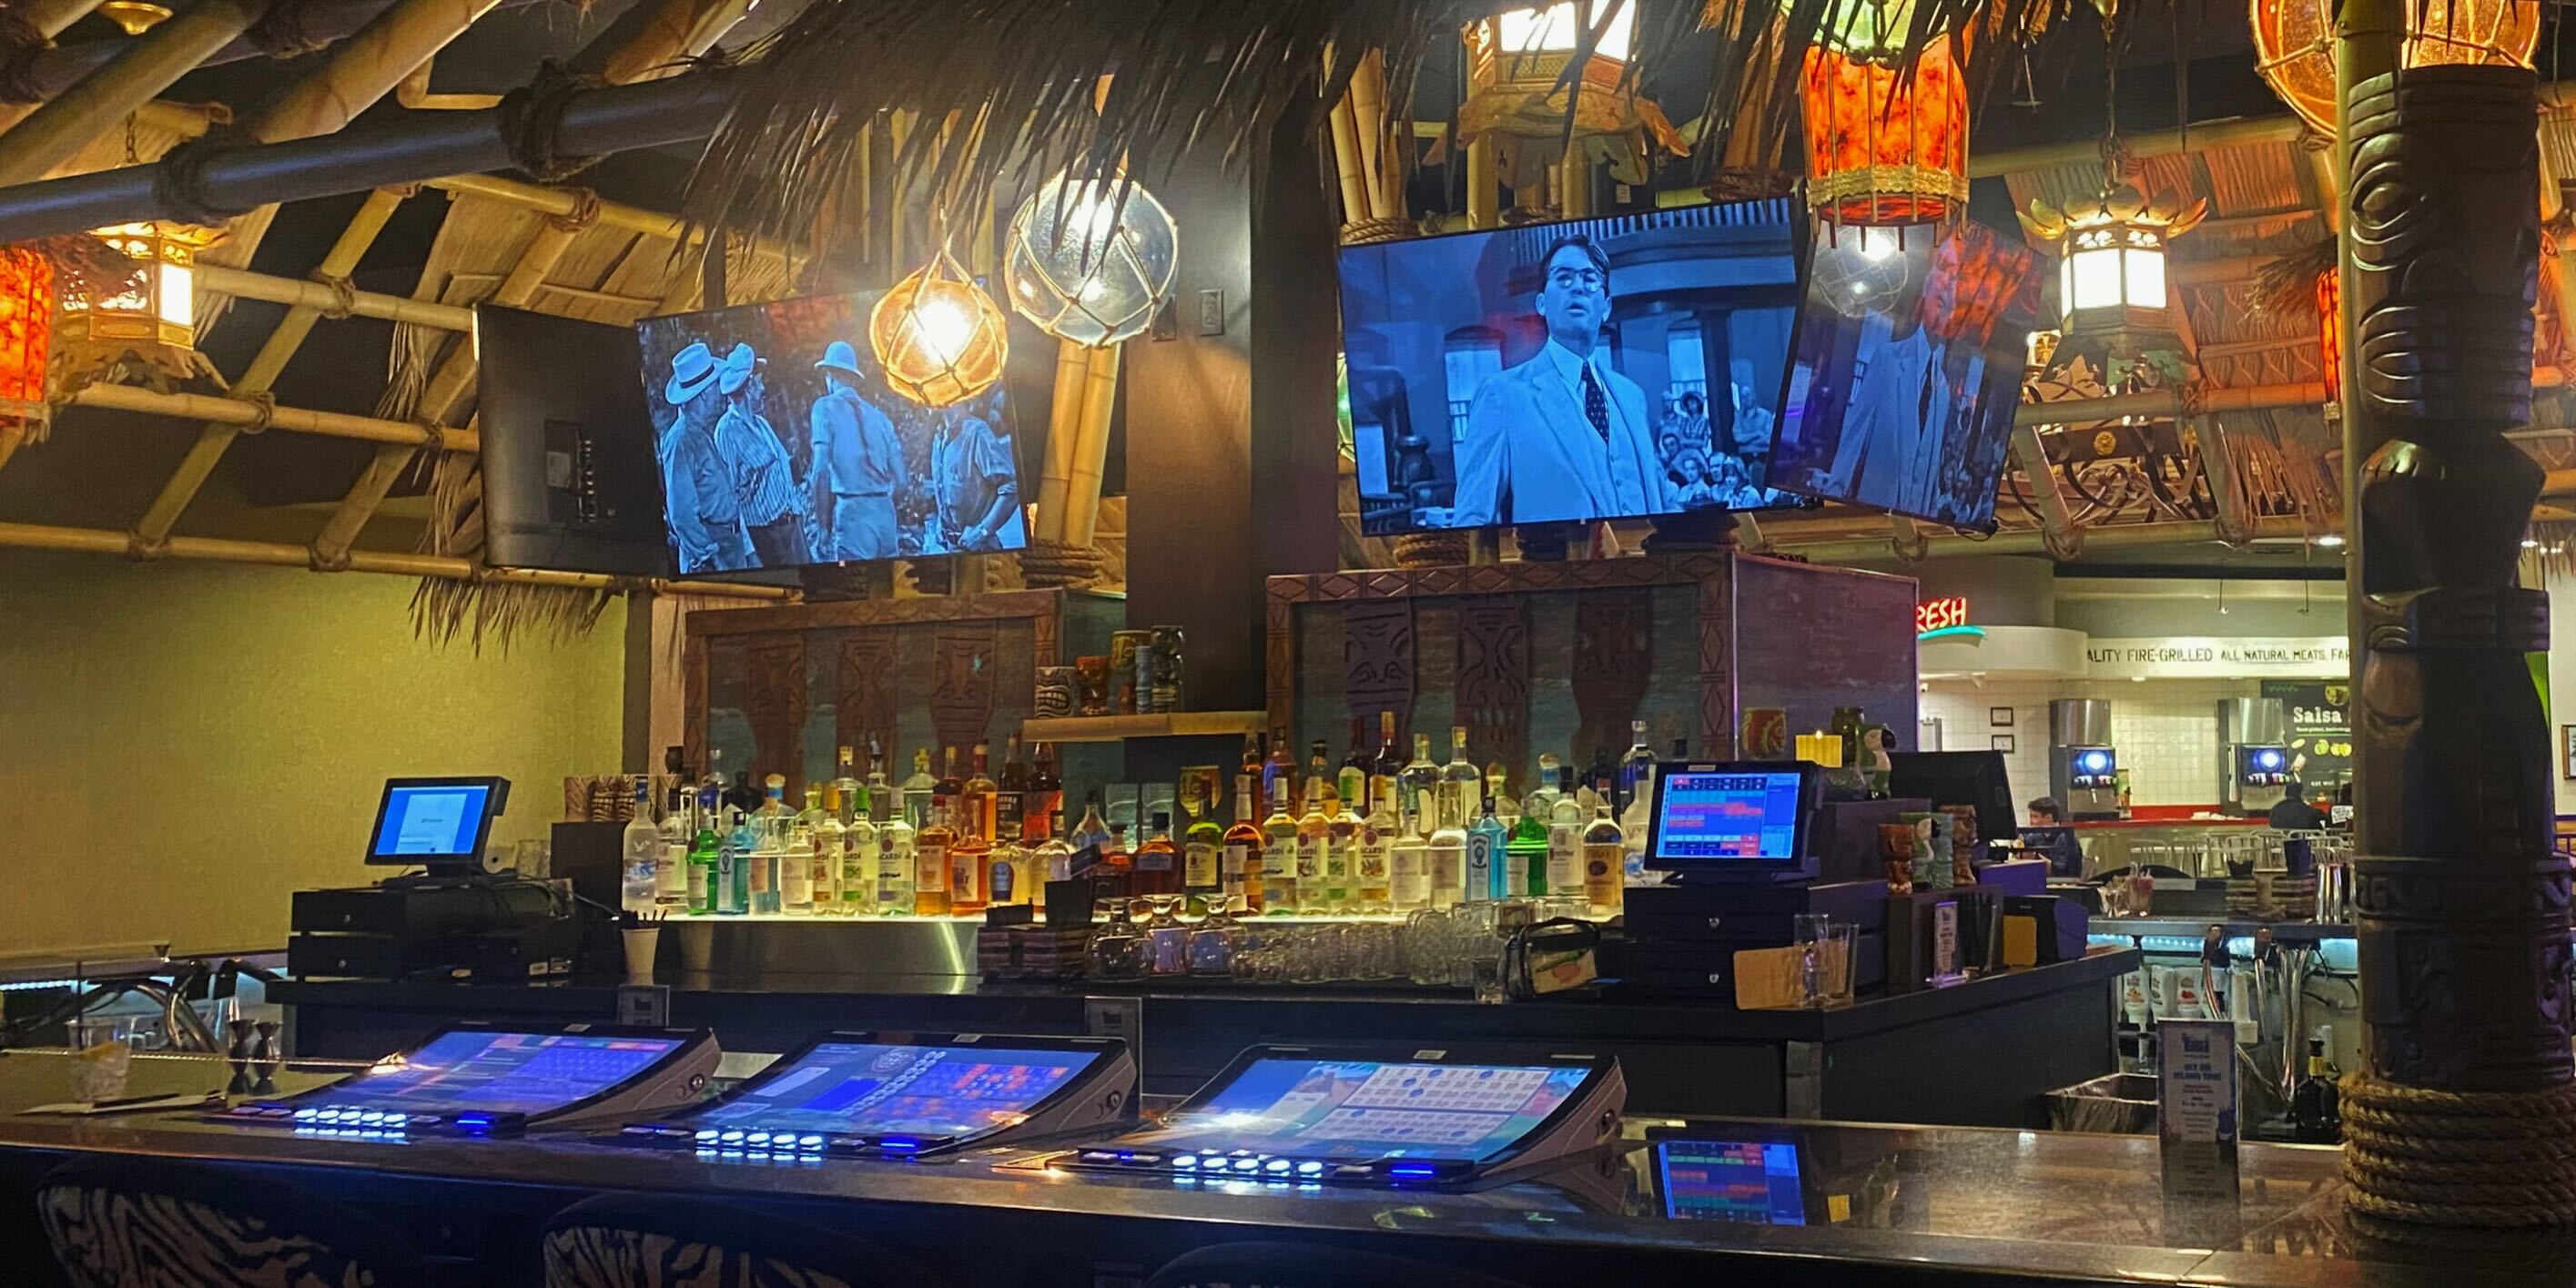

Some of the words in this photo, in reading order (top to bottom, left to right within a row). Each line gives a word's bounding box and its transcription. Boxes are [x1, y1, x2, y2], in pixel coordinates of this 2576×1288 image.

[2087, 648, 2121, 663] ALITY
[2126, 647, 2213, 663] FIRE-GRILLED
[2221, 649, 2240, 661] ALL
[2244, 649, 2290, 661] NATURAL
[2293, 705, 2342, 724] Salsa
